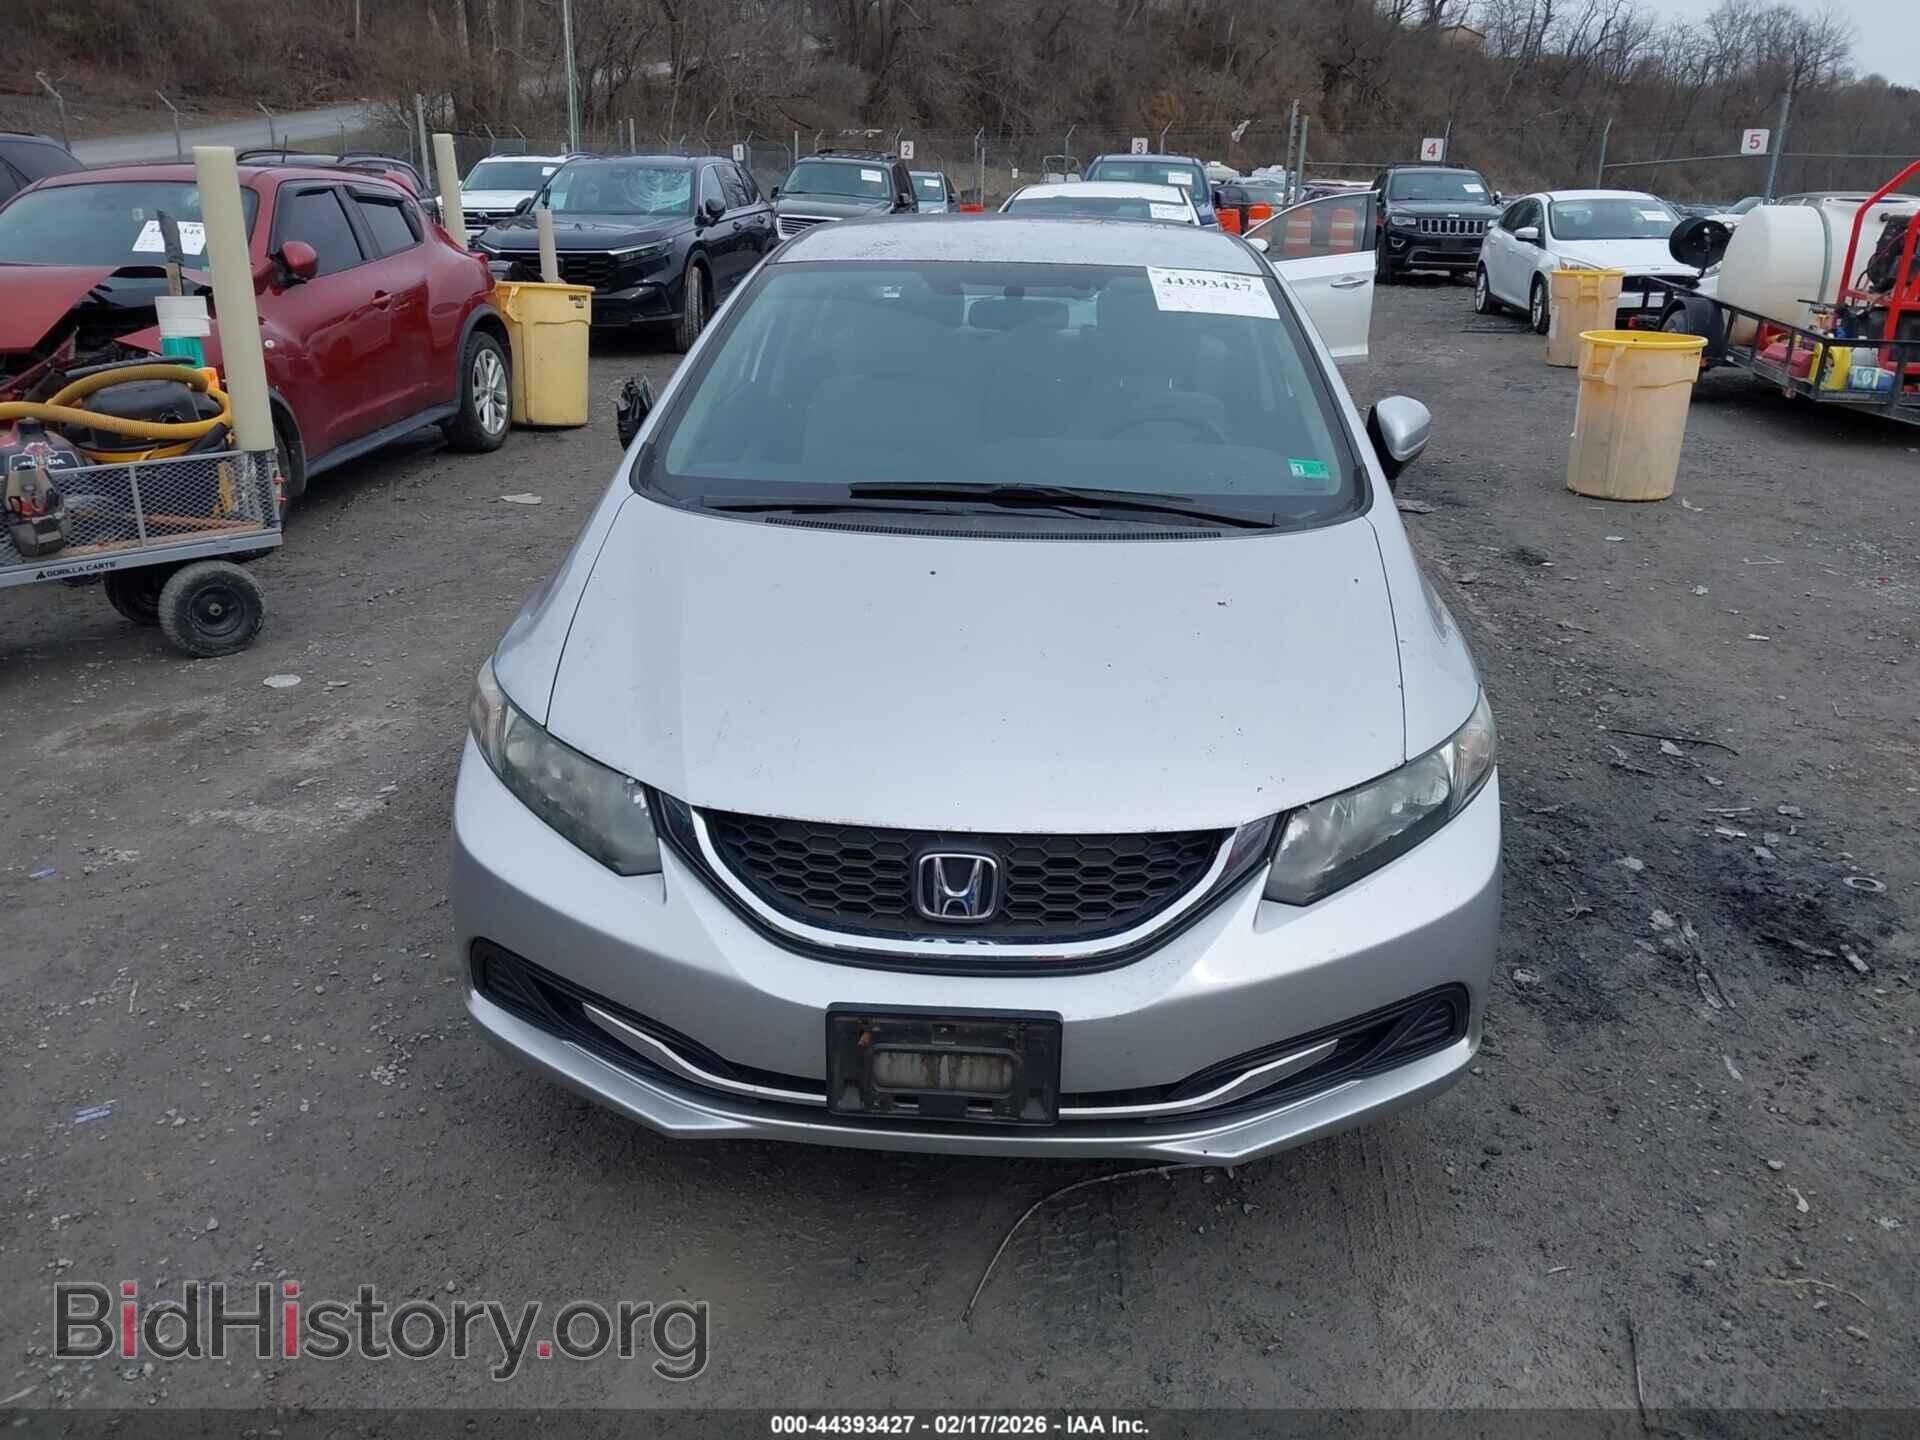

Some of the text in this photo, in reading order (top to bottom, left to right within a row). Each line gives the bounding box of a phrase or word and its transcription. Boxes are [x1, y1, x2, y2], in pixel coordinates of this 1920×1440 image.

[1136, 141, 1143, 153] 3
[1750, 134, 1761, 149] 5
[904, 144, 911, 156] 2
[1427, 142, 1437, 157] 4
[1162, 277, 1251, 292] 44393427
[47, 567, 84, 577] GORILLA
